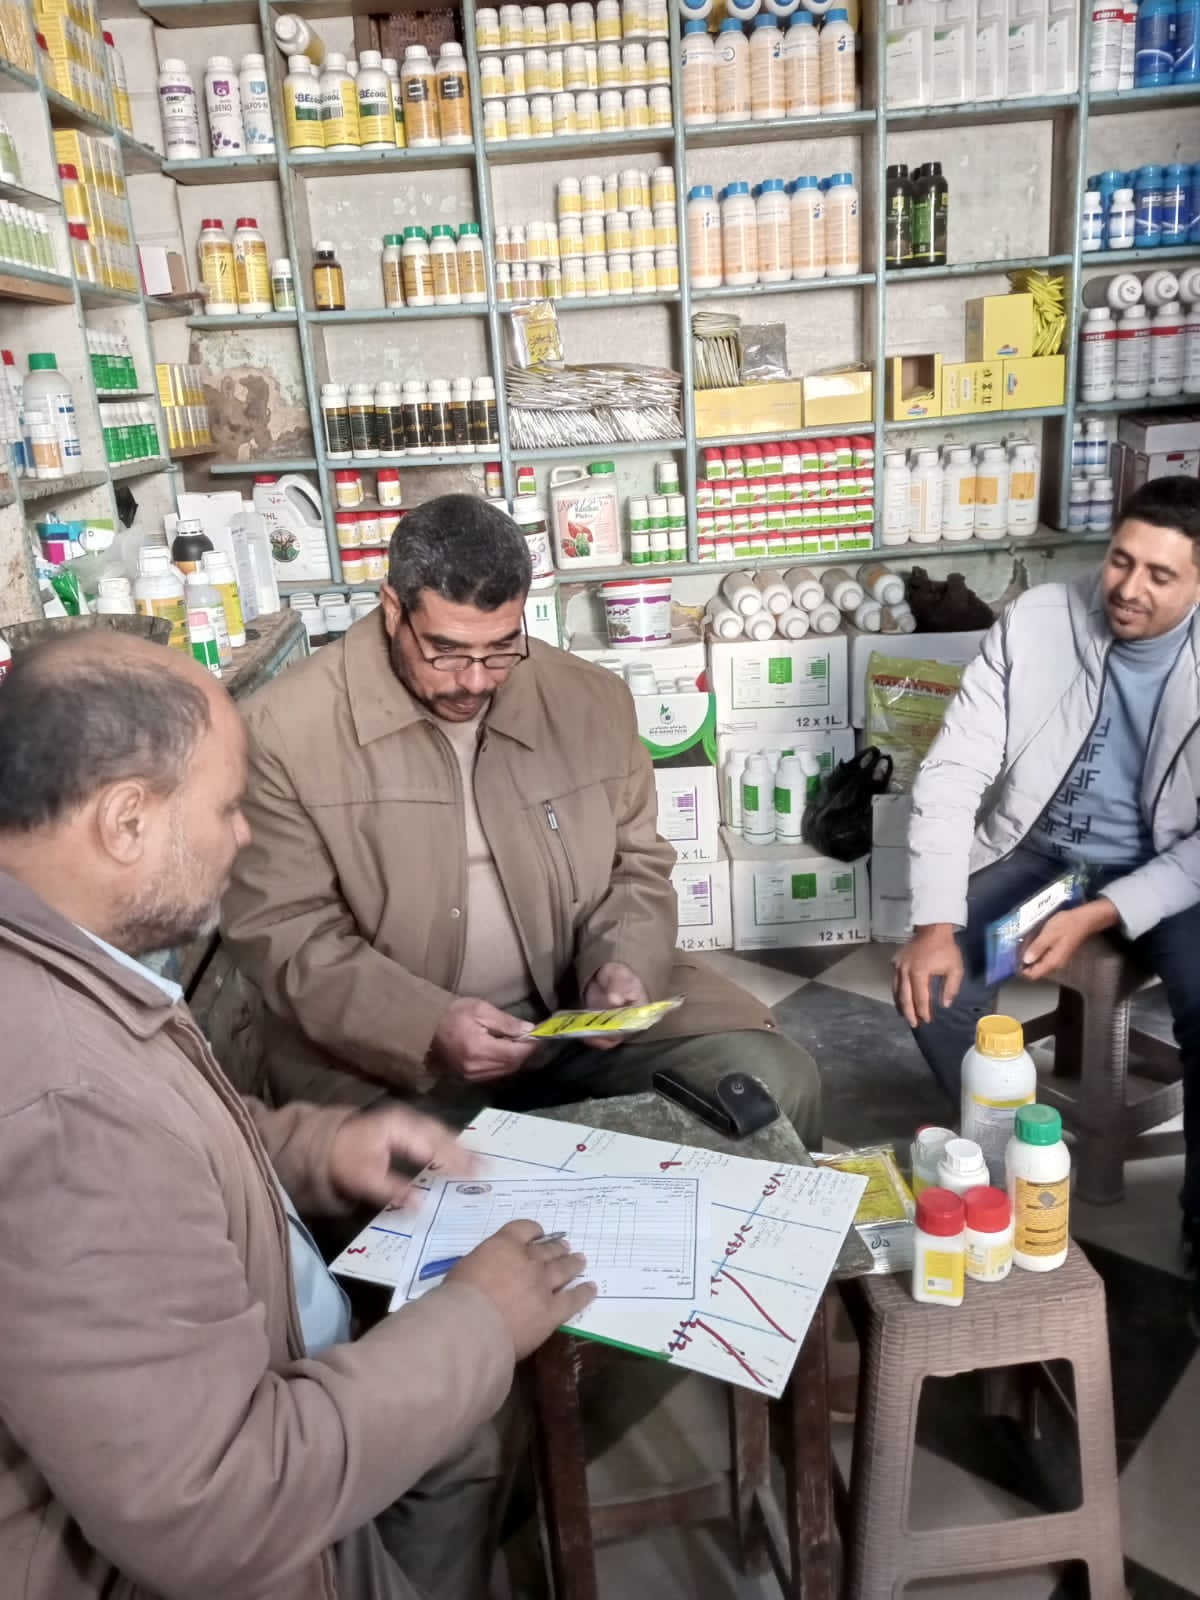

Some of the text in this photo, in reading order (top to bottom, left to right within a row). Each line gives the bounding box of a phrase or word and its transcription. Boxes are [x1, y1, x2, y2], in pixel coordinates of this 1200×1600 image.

[796, 716, 810, 727] 12
[819, 930, 833, 941] 12
[681, 939, 695, 949] 12
